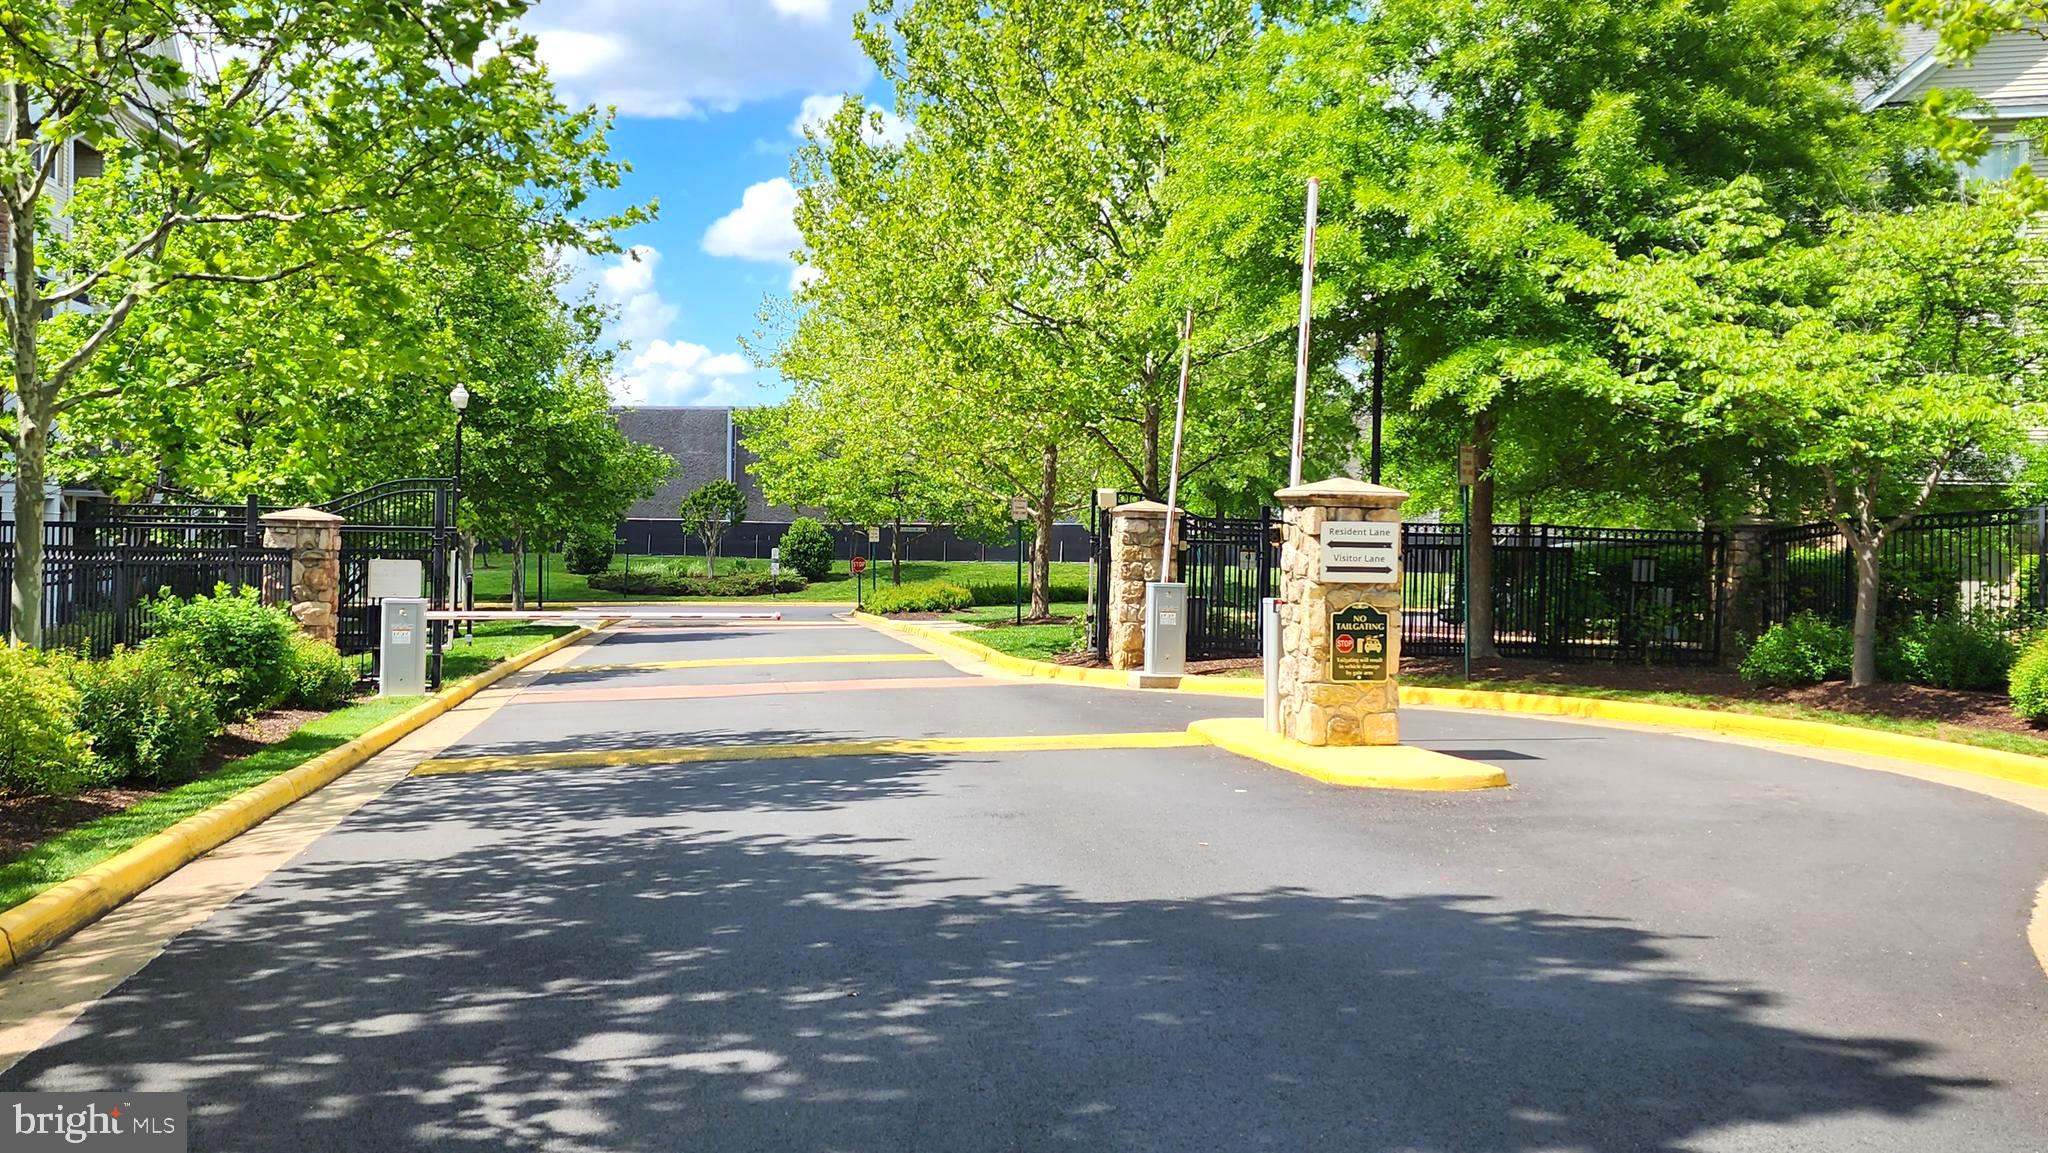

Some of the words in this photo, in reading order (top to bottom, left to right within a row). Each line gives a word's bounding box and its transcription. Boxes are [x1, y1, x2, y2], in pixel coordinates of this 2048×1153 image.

[1329, 528, 1367, 536] Resident
[1333, 554, 1362, 562] Visitor
[1364, 555, 1386, 563] Lane
[1335, 623, 1385, 631] TAILGATING
[1337, 640, 1353, 648] STOP
